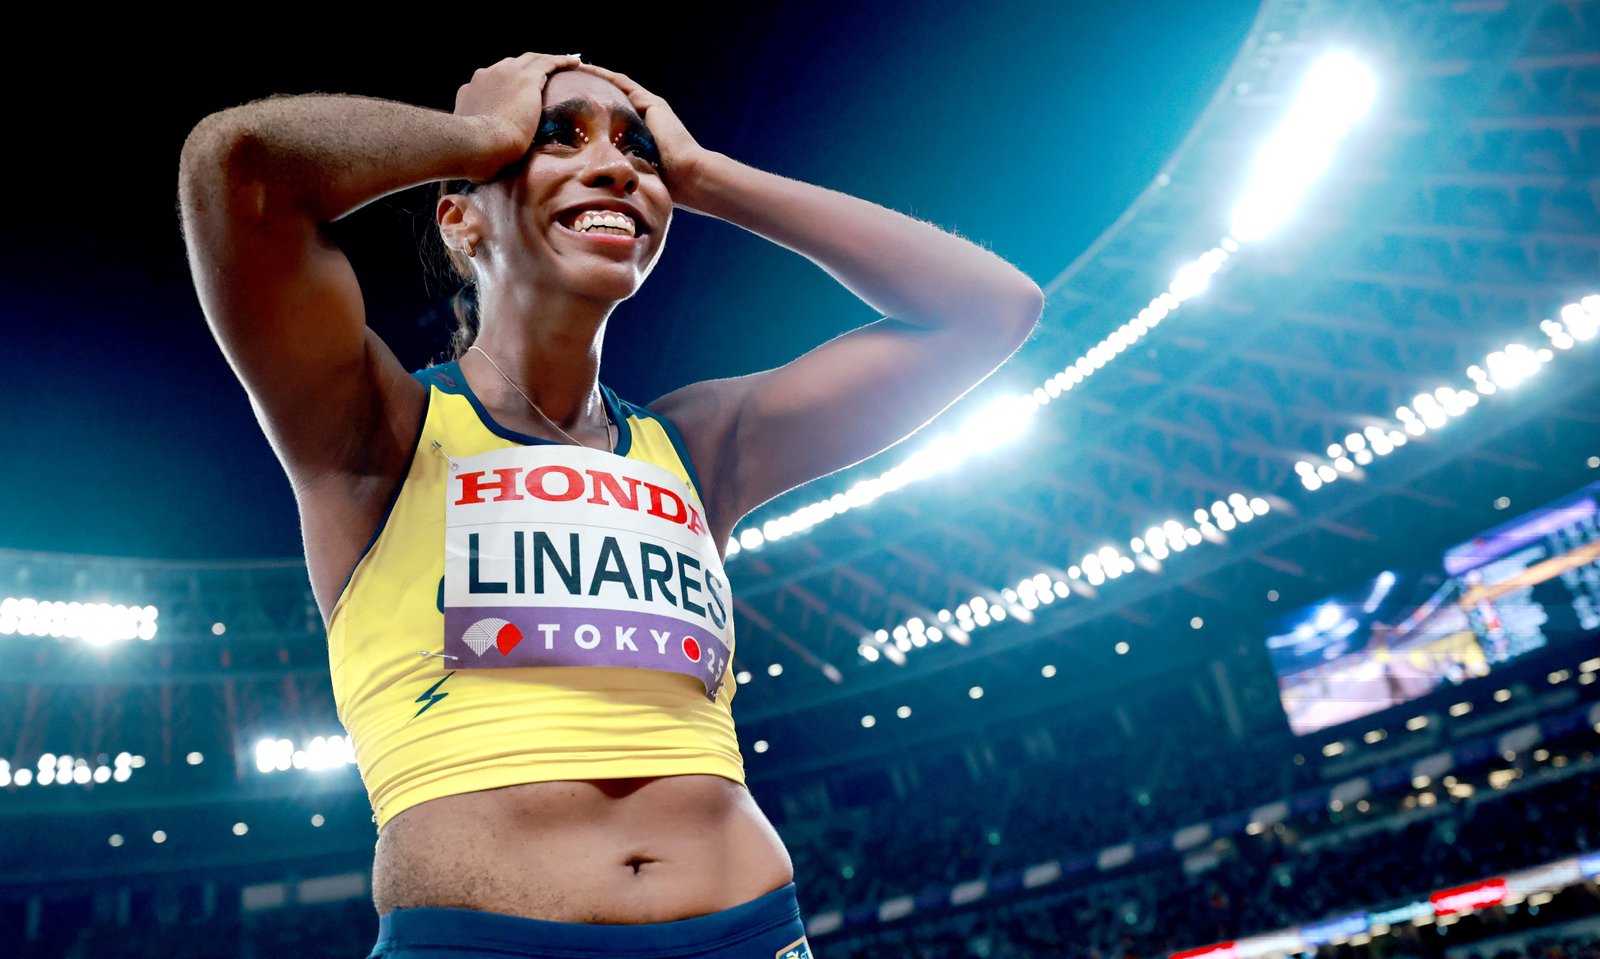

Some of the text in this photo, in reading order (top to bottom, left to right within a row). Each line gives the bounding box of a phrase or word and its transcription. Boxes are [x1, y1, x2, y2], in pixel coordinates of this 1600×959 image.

[455, 465, 706, 536] HONDA
[468, 531, 727, 630] LINARES
[707, 647, 724, 683] 25
